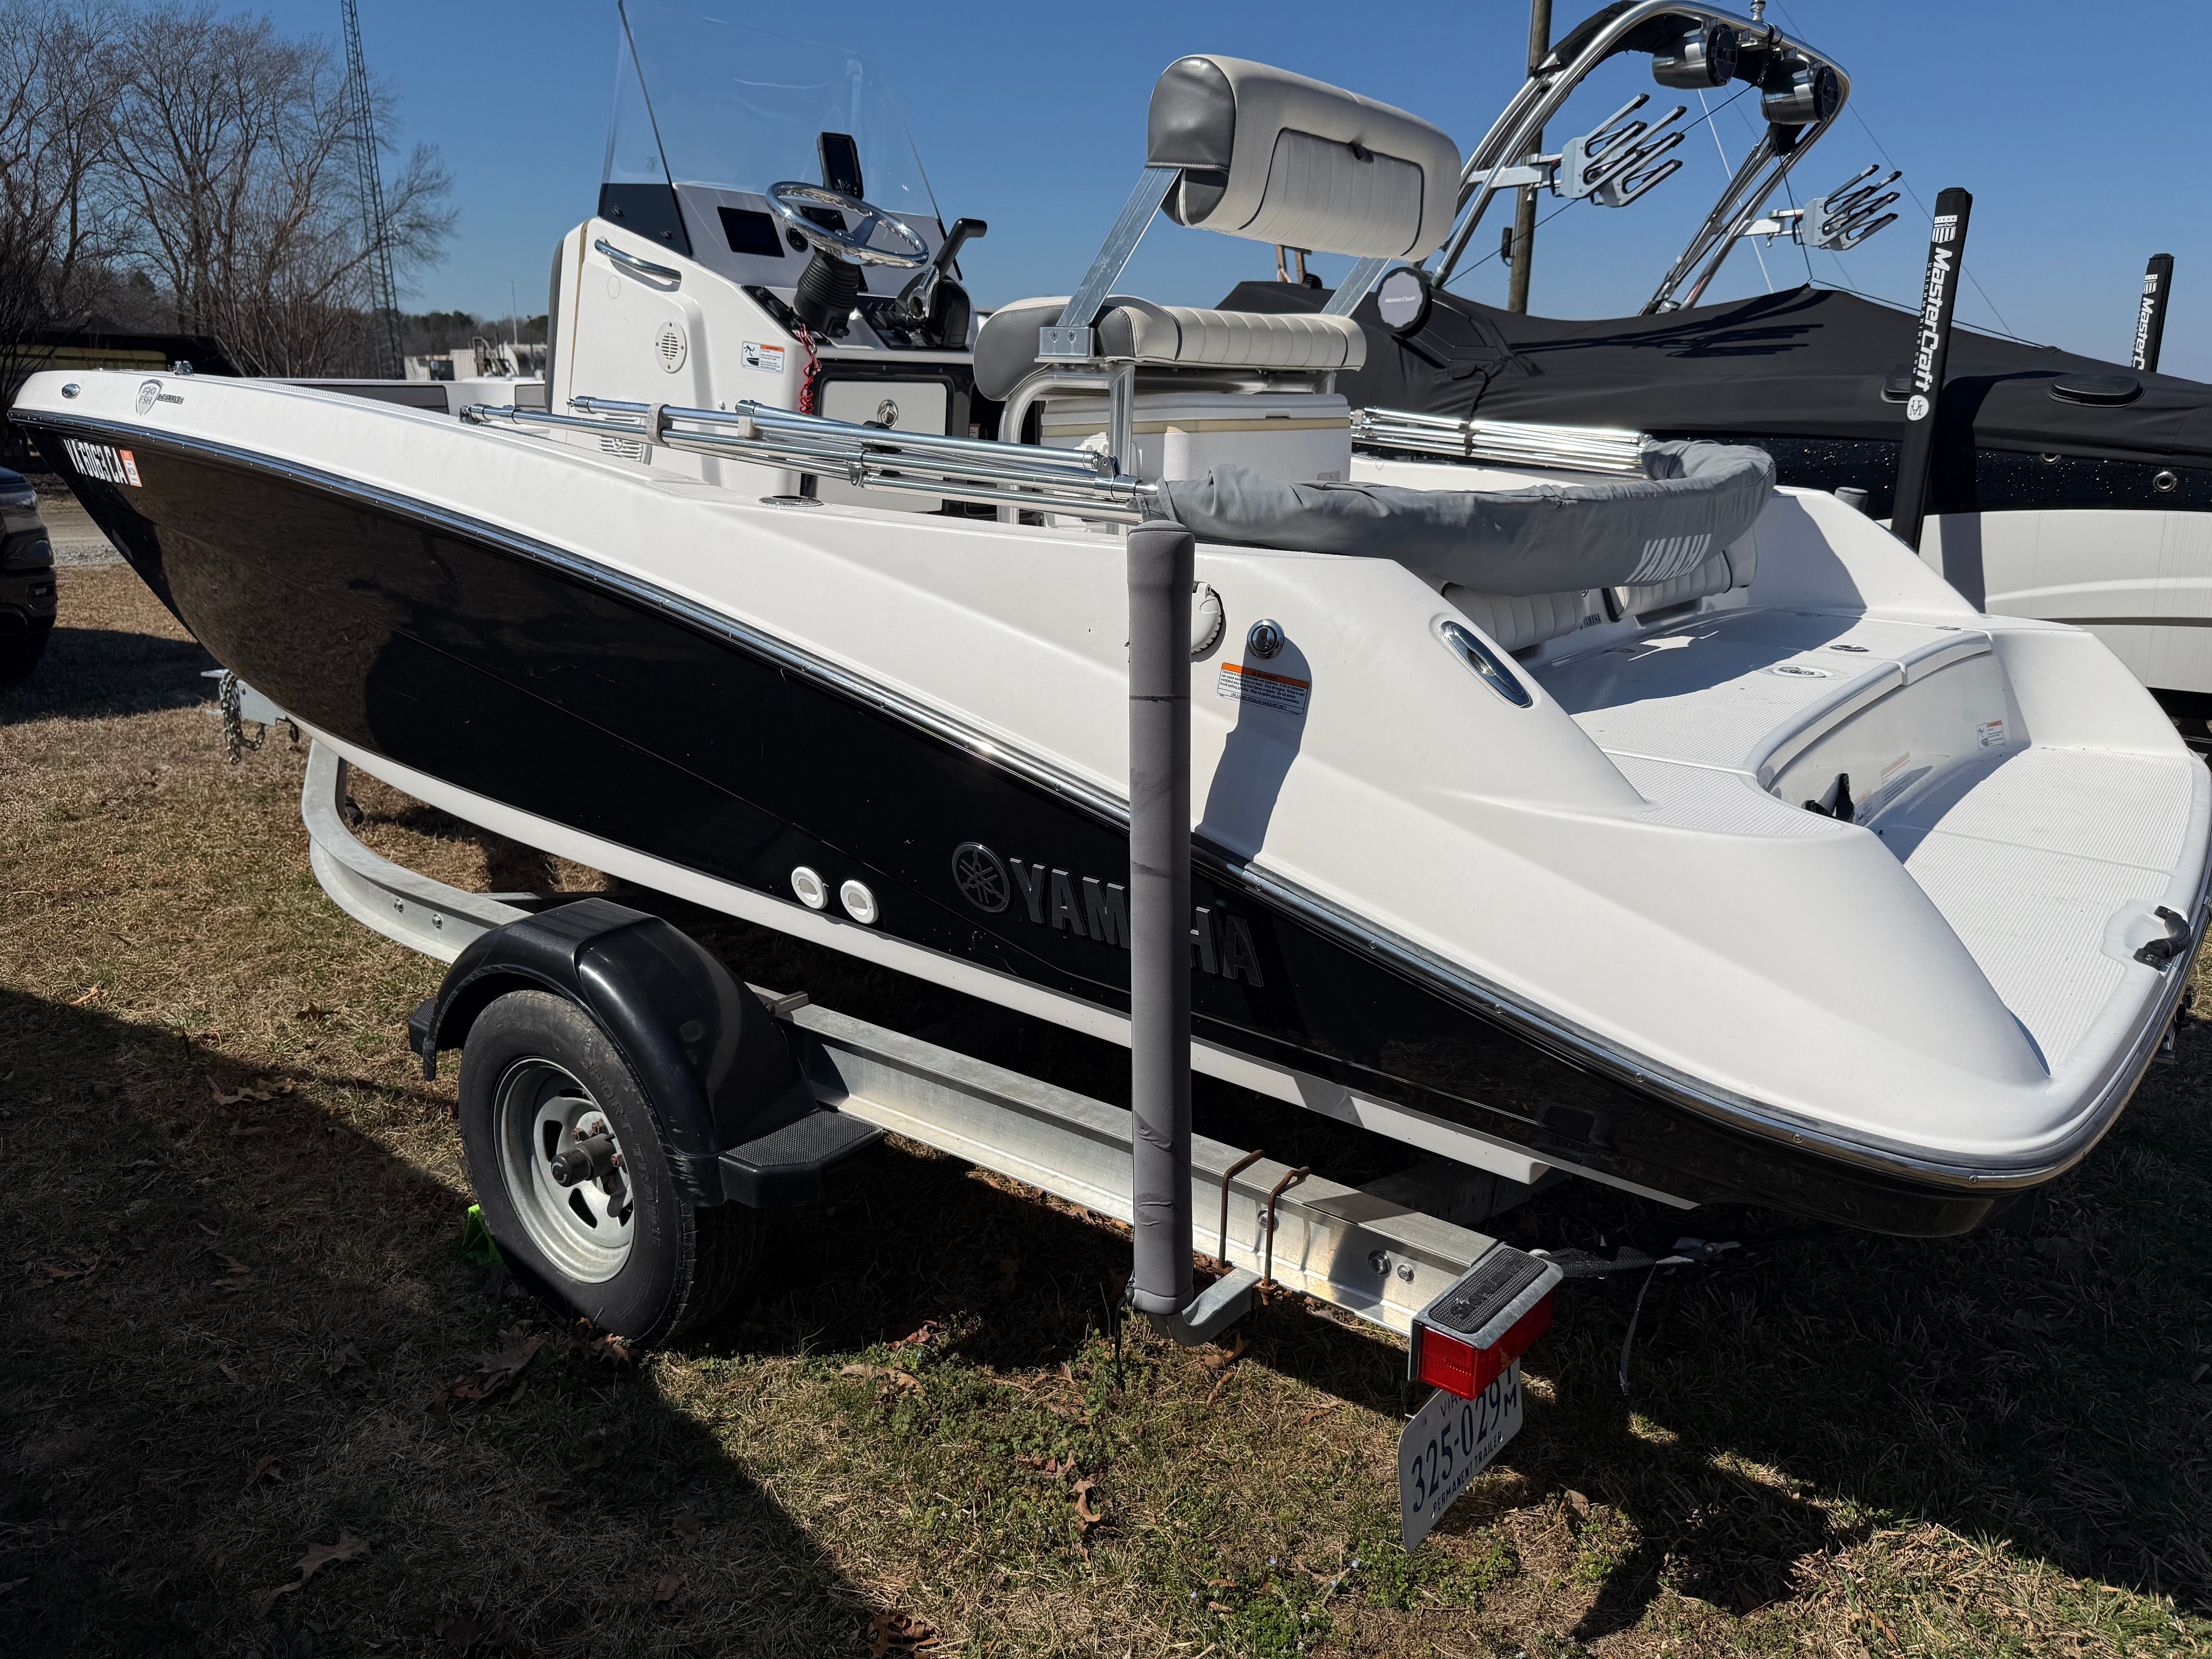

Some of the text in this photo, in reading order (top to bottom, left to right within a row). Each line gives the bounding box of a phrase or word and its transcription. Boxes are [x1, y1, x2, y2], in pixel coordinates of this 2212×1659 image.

[1915, 247, 1952, 392] MasterCraft
[2133, 297, 2154, 370] MasterC
[139, 396, 152, 405] FSH
[159, 394, 184, 404] DELUXE
[1623, 533, 1712, 583] YAMAHA
[1583, 613, 1602, 629] YAMAHA
[1010, 857, 1264, 987] YAMHA
[579, 1053, 634, 1133] SPORT
[1412, 1377, 1501, 1513] 325-029
[1433, 1431, 1502, 1513] PERMANENT TRAILER
